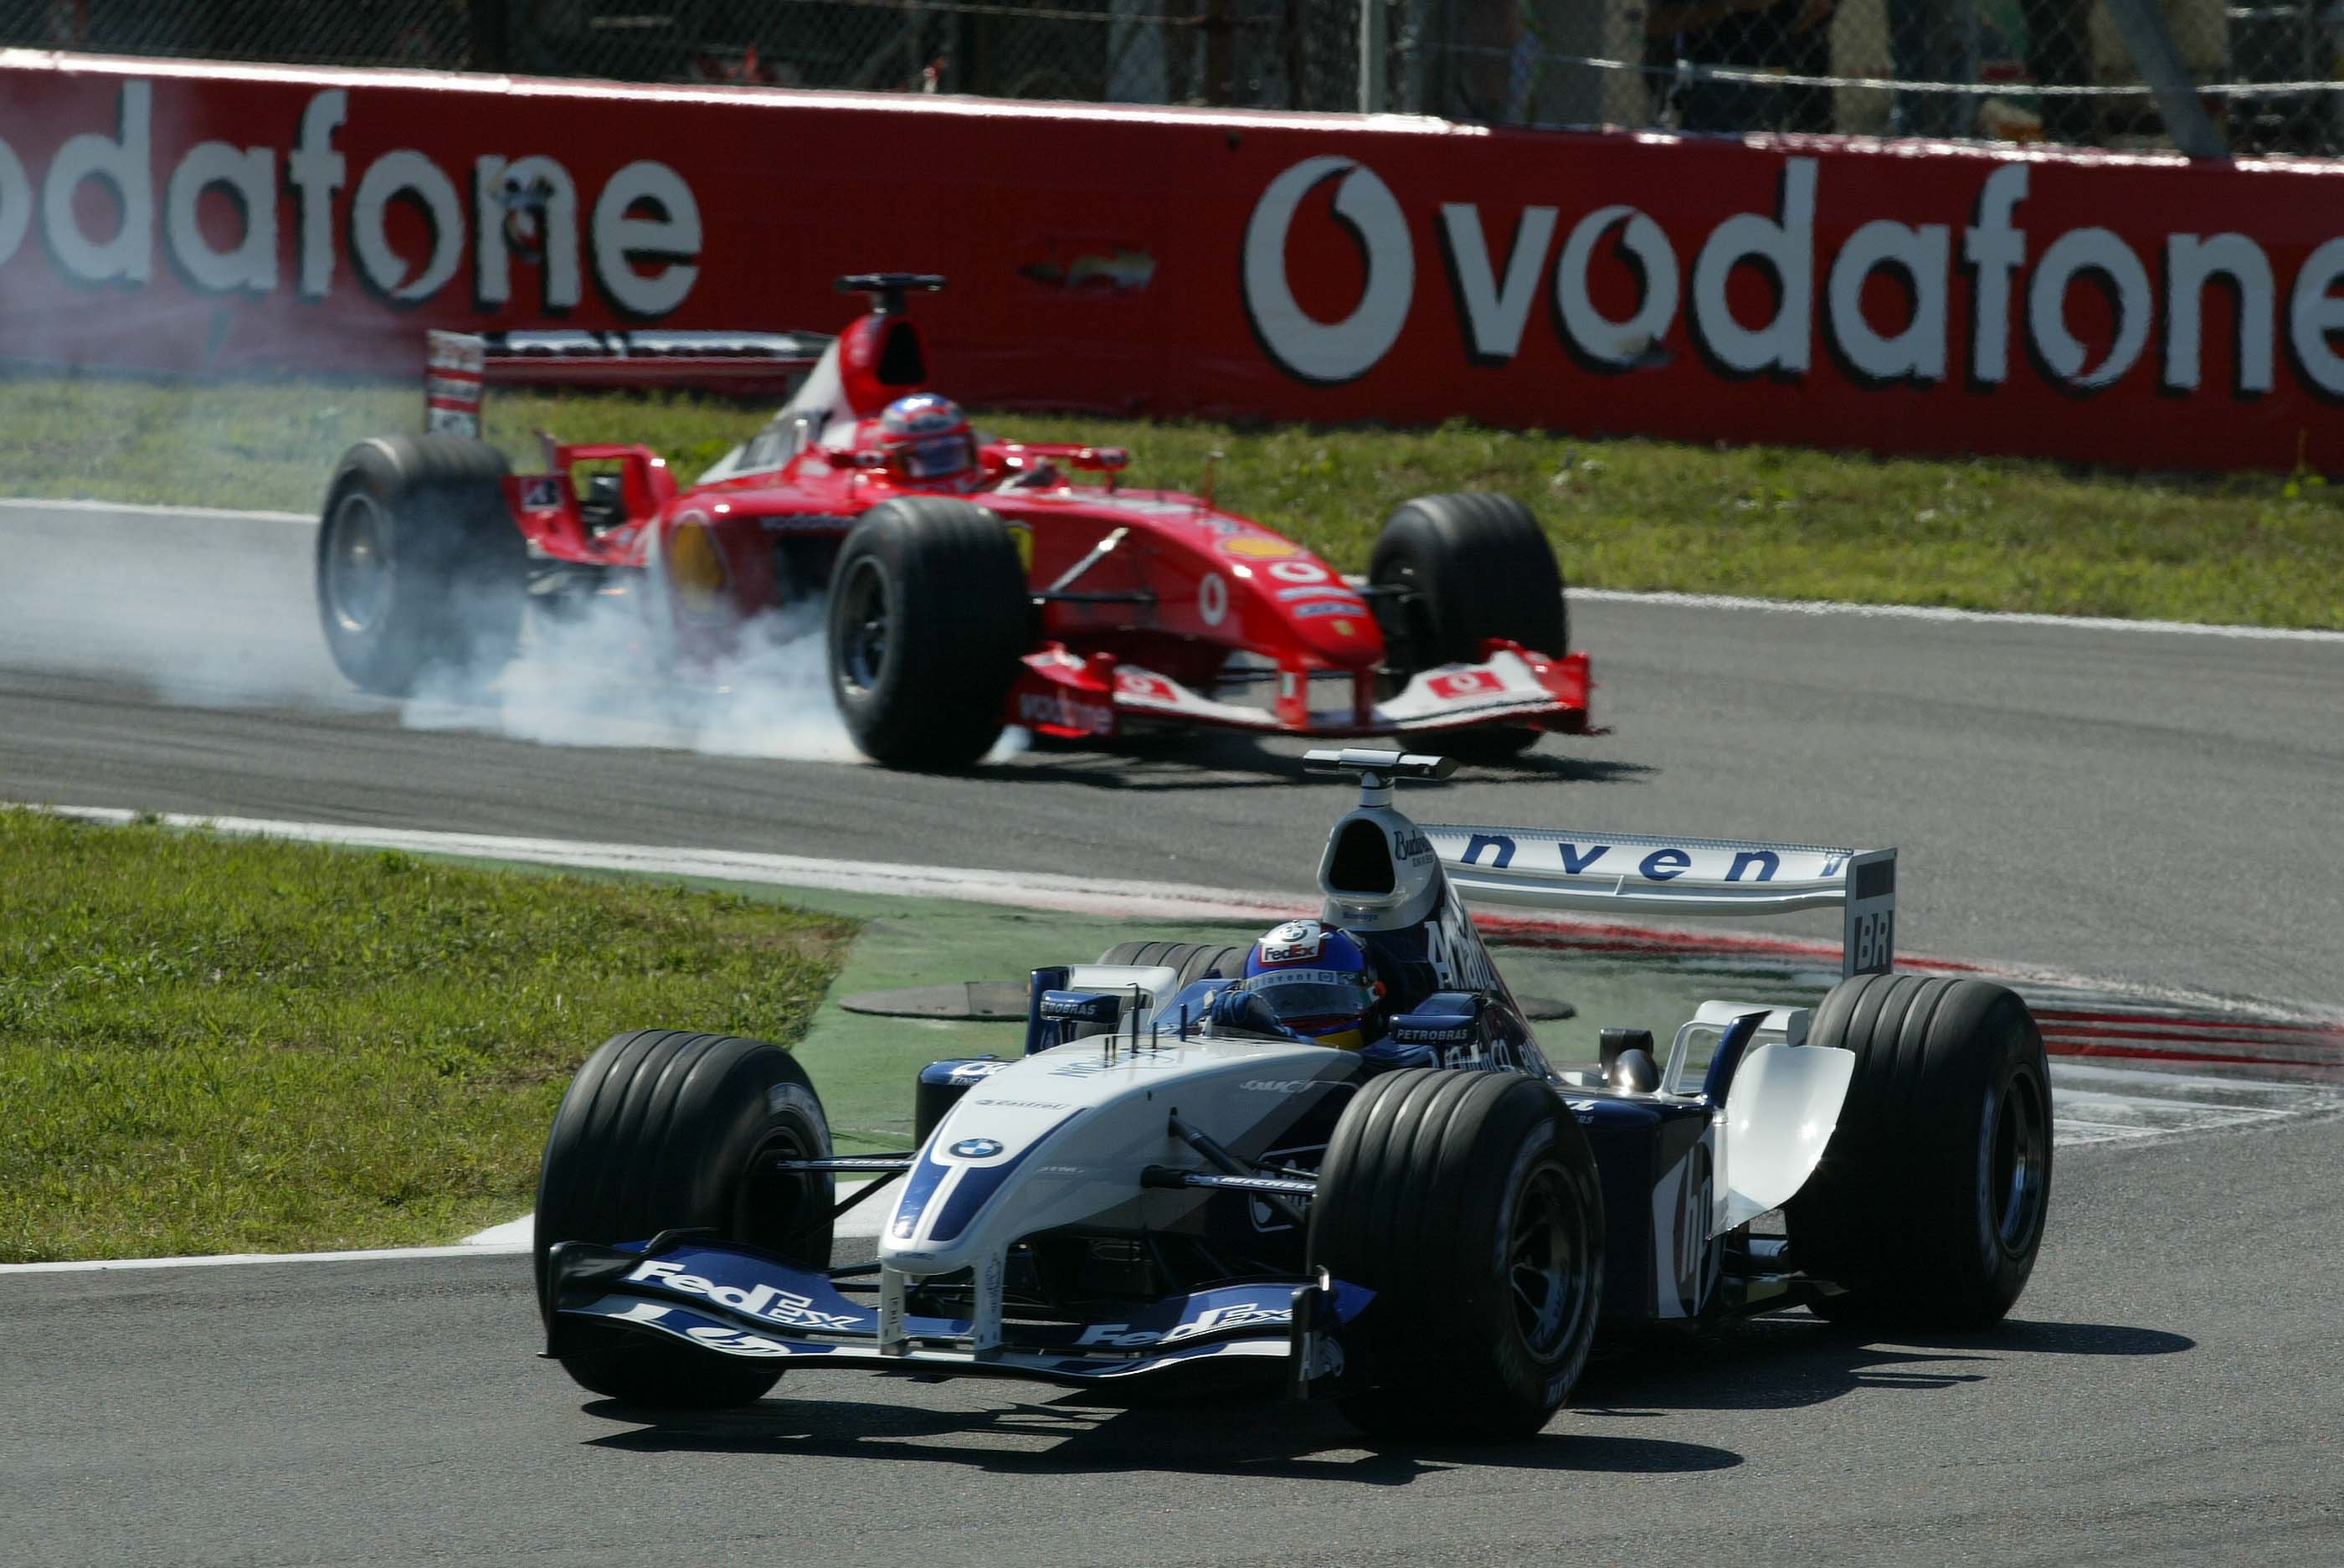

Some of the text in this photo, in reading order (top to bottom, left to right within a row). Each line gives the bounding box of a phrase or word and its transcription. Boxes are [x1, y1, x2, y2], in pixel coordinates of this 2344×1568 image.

[0, 80, 703, 317] dafone
[1264, 943, 1315, 961] FedEx
[1396, 1029, 1468, 1041] PETROBRAS
[629, 1260, 865, 1329] FedEx
[1075, 1303, 1293, 1345] FedEx
